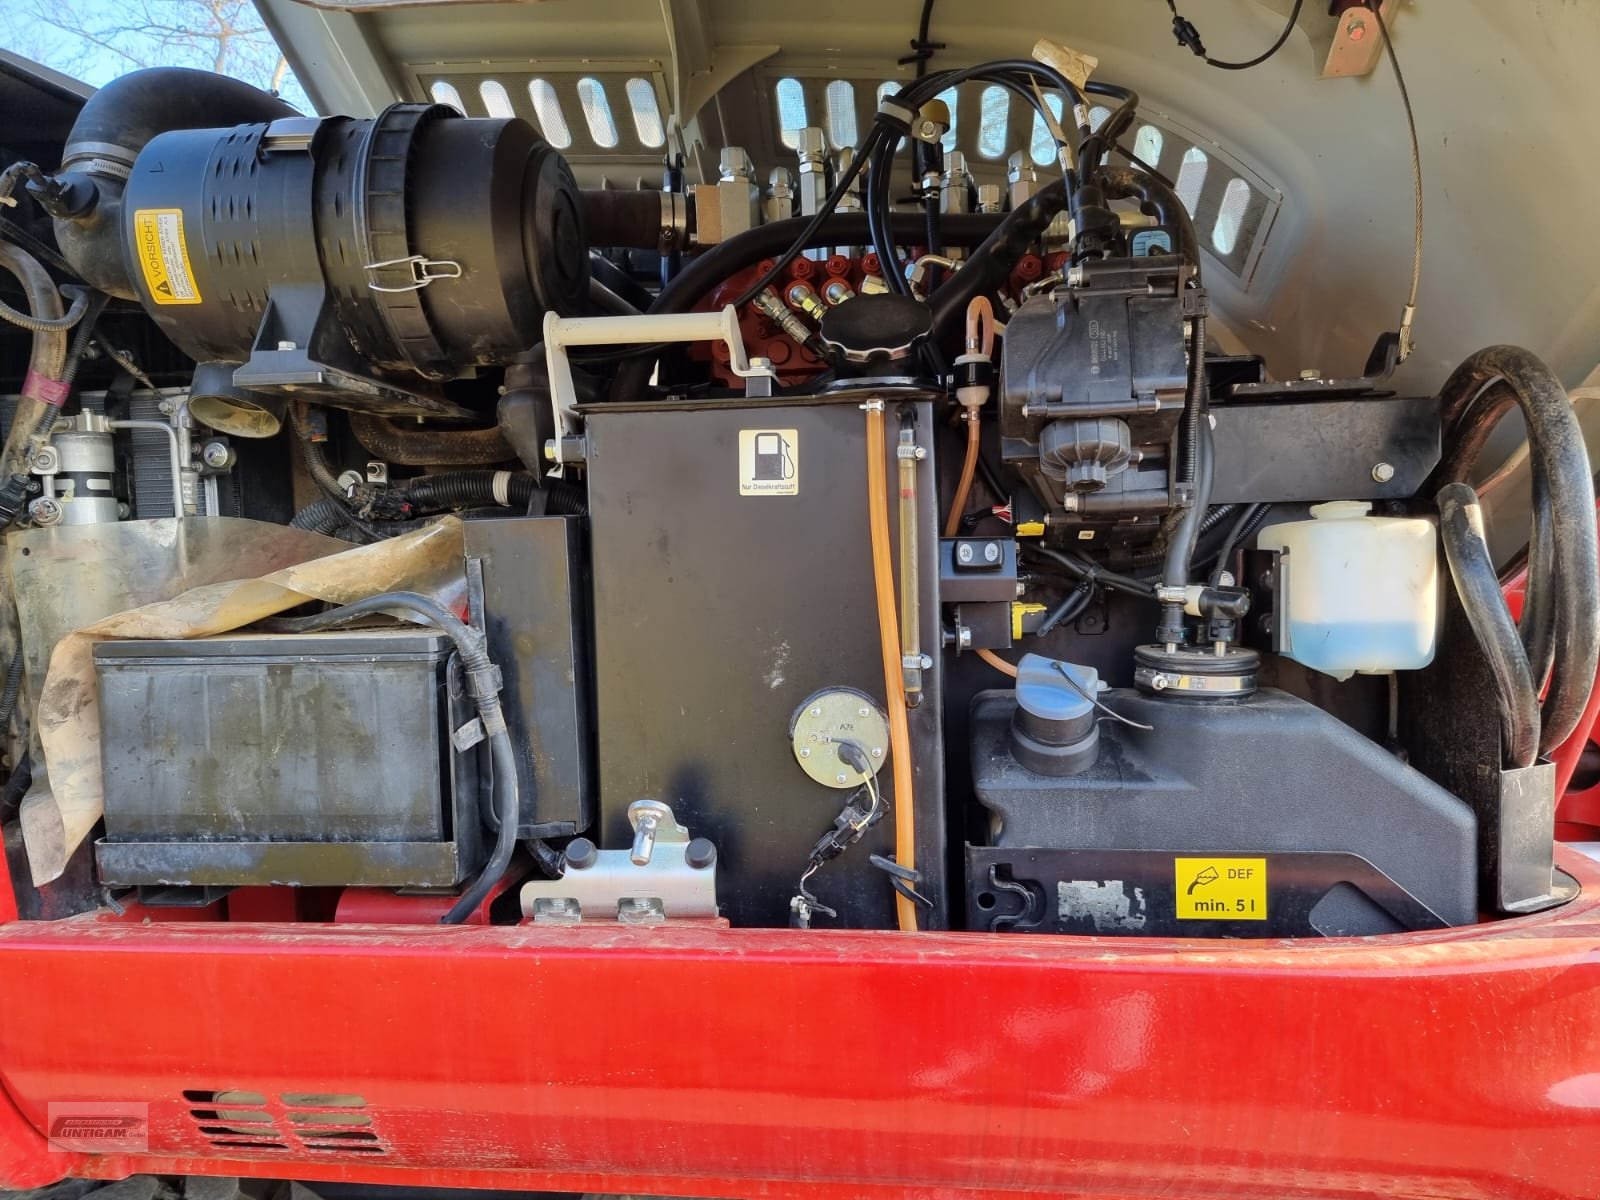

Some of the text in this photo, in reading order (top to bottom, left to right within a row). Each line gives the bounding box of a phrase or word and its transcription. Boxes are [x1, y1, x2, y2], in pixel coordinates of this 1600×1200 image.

[144, 219, 161, 277] VORSICHT
[1228, 868, 1253, 879] DEF
[1194, 898, 1230, 912] min.
[1236, 899, 1245, 912] 5
